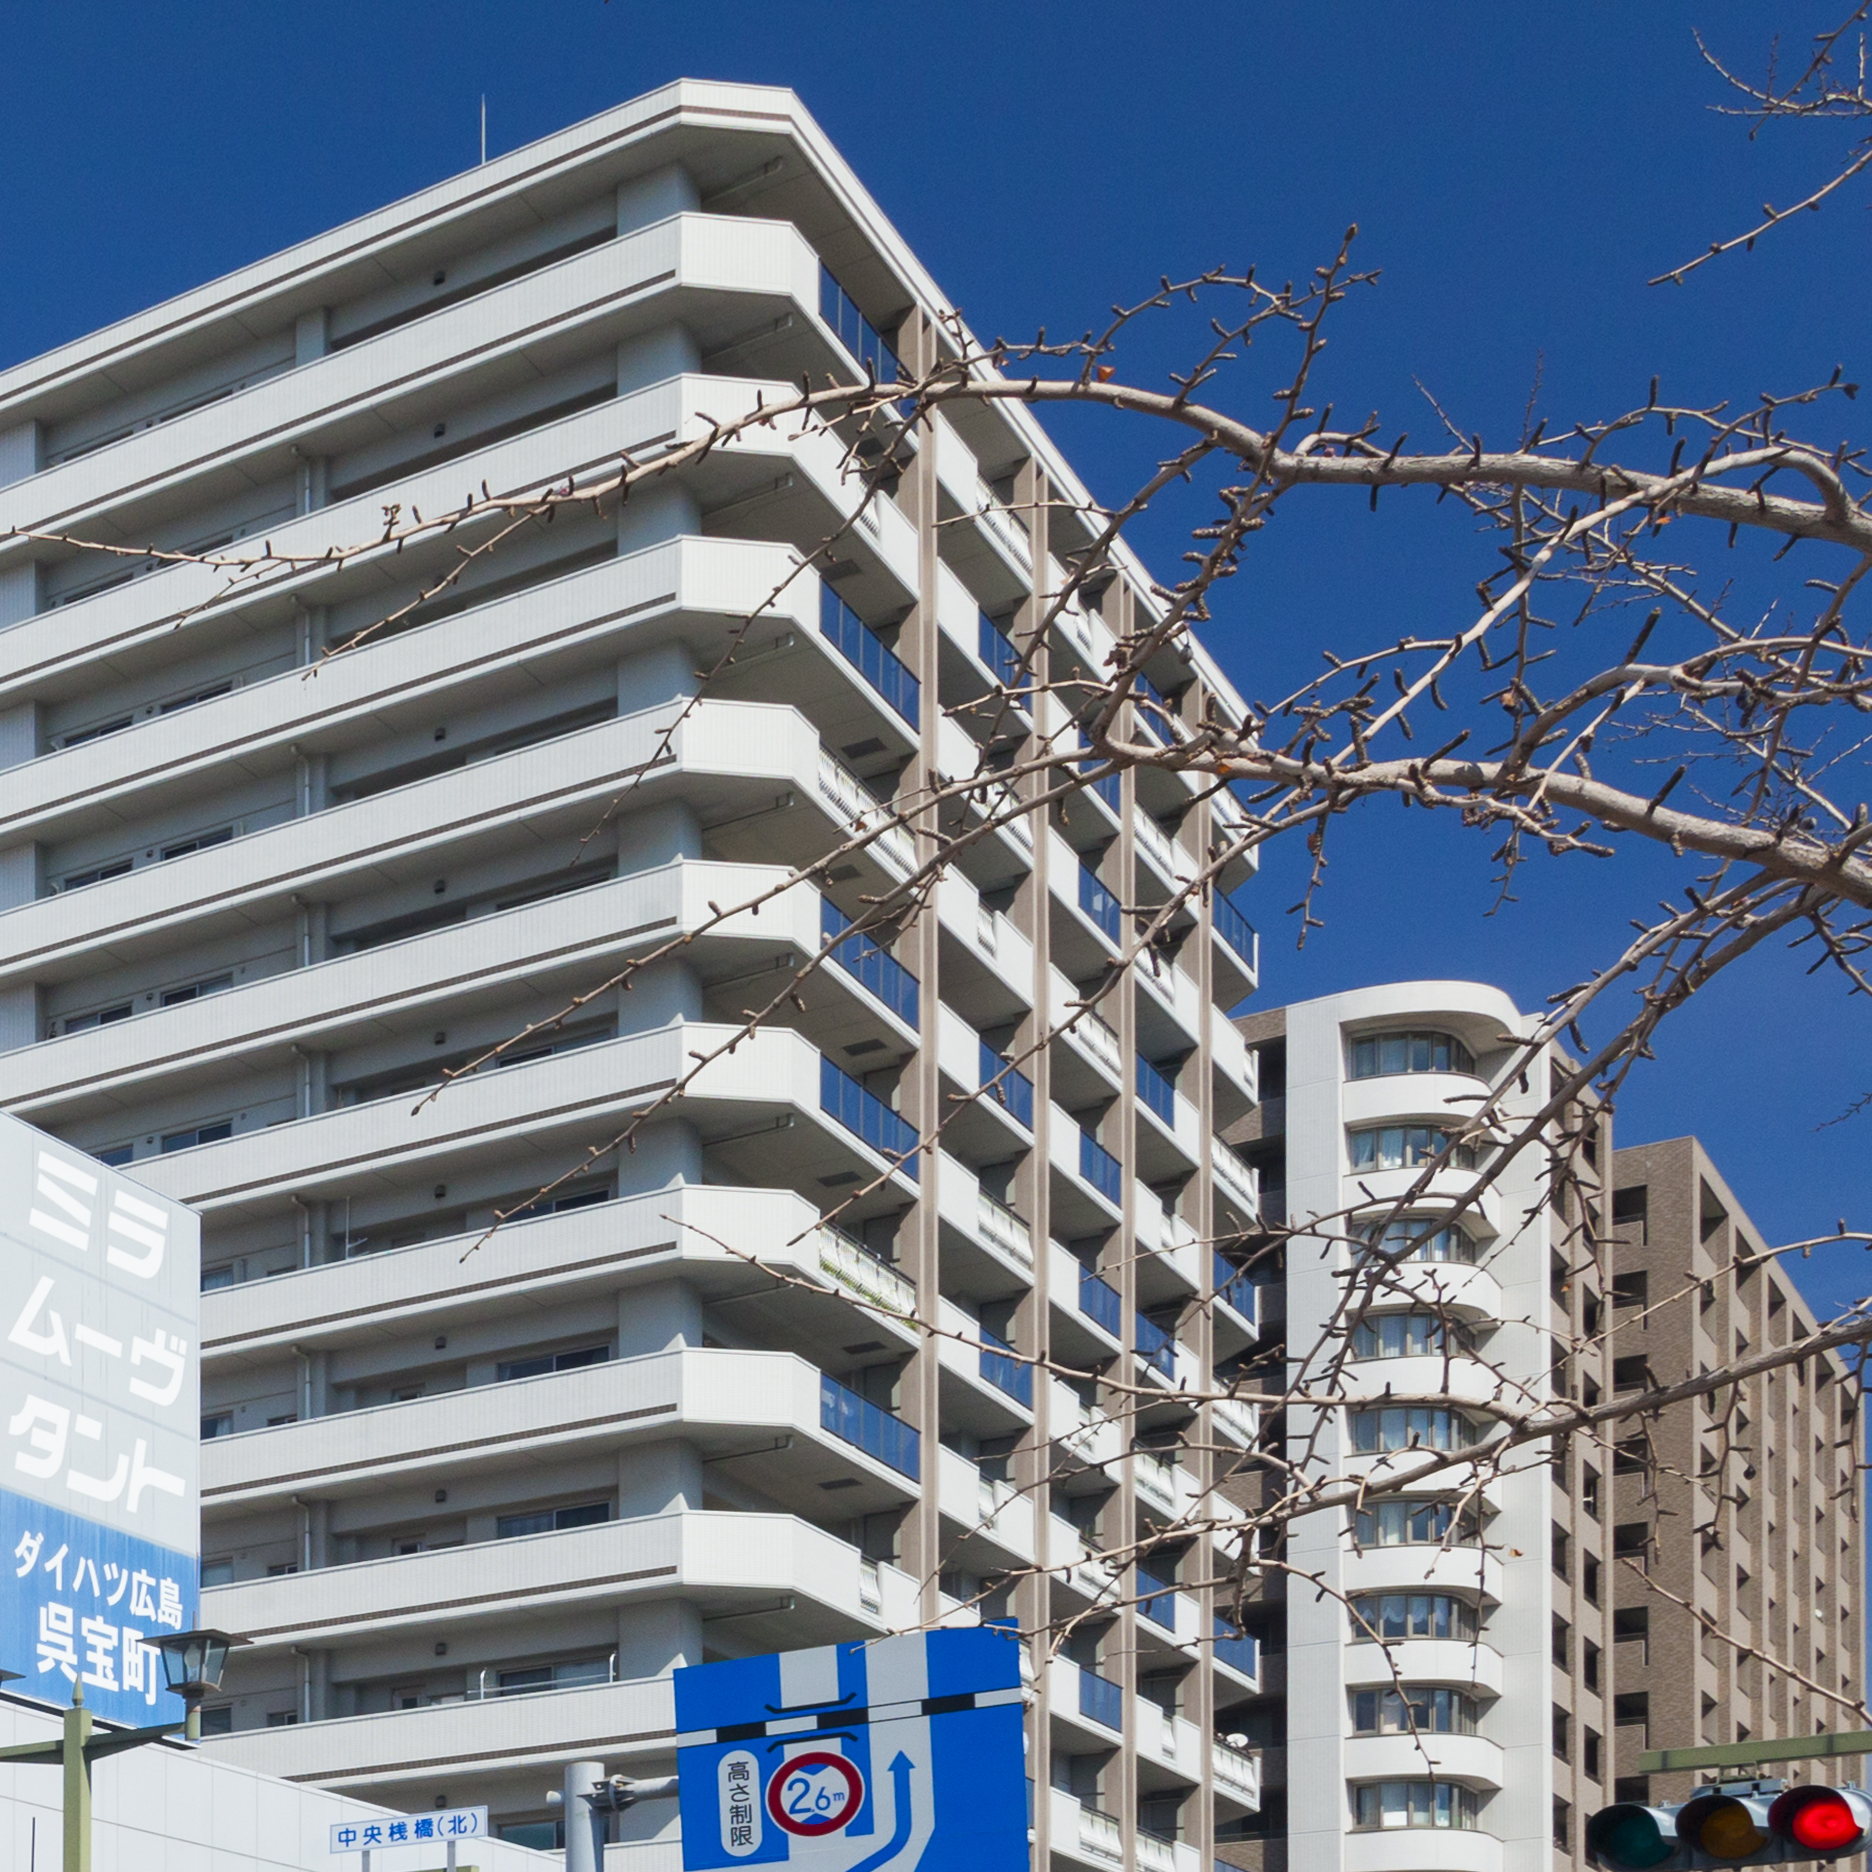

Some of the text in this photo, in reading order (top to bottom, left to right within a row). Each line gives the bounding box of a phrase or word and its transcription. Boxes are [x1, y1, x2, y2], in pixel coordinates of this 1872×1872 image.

[29, 1150, 168, 1279] ミラ
[7, 1275, 187, 1407] ムーヴ
[8, 1394, 186, 1513] タント
[14, 1530, 183, 1630] ダイハツ広島
[37, 1602, 160, 1706] 呉宝町
[338, 1813, 477, 1847] 中央桟橋(北)
[728, 1761, 753, 1846] 高さ制限
